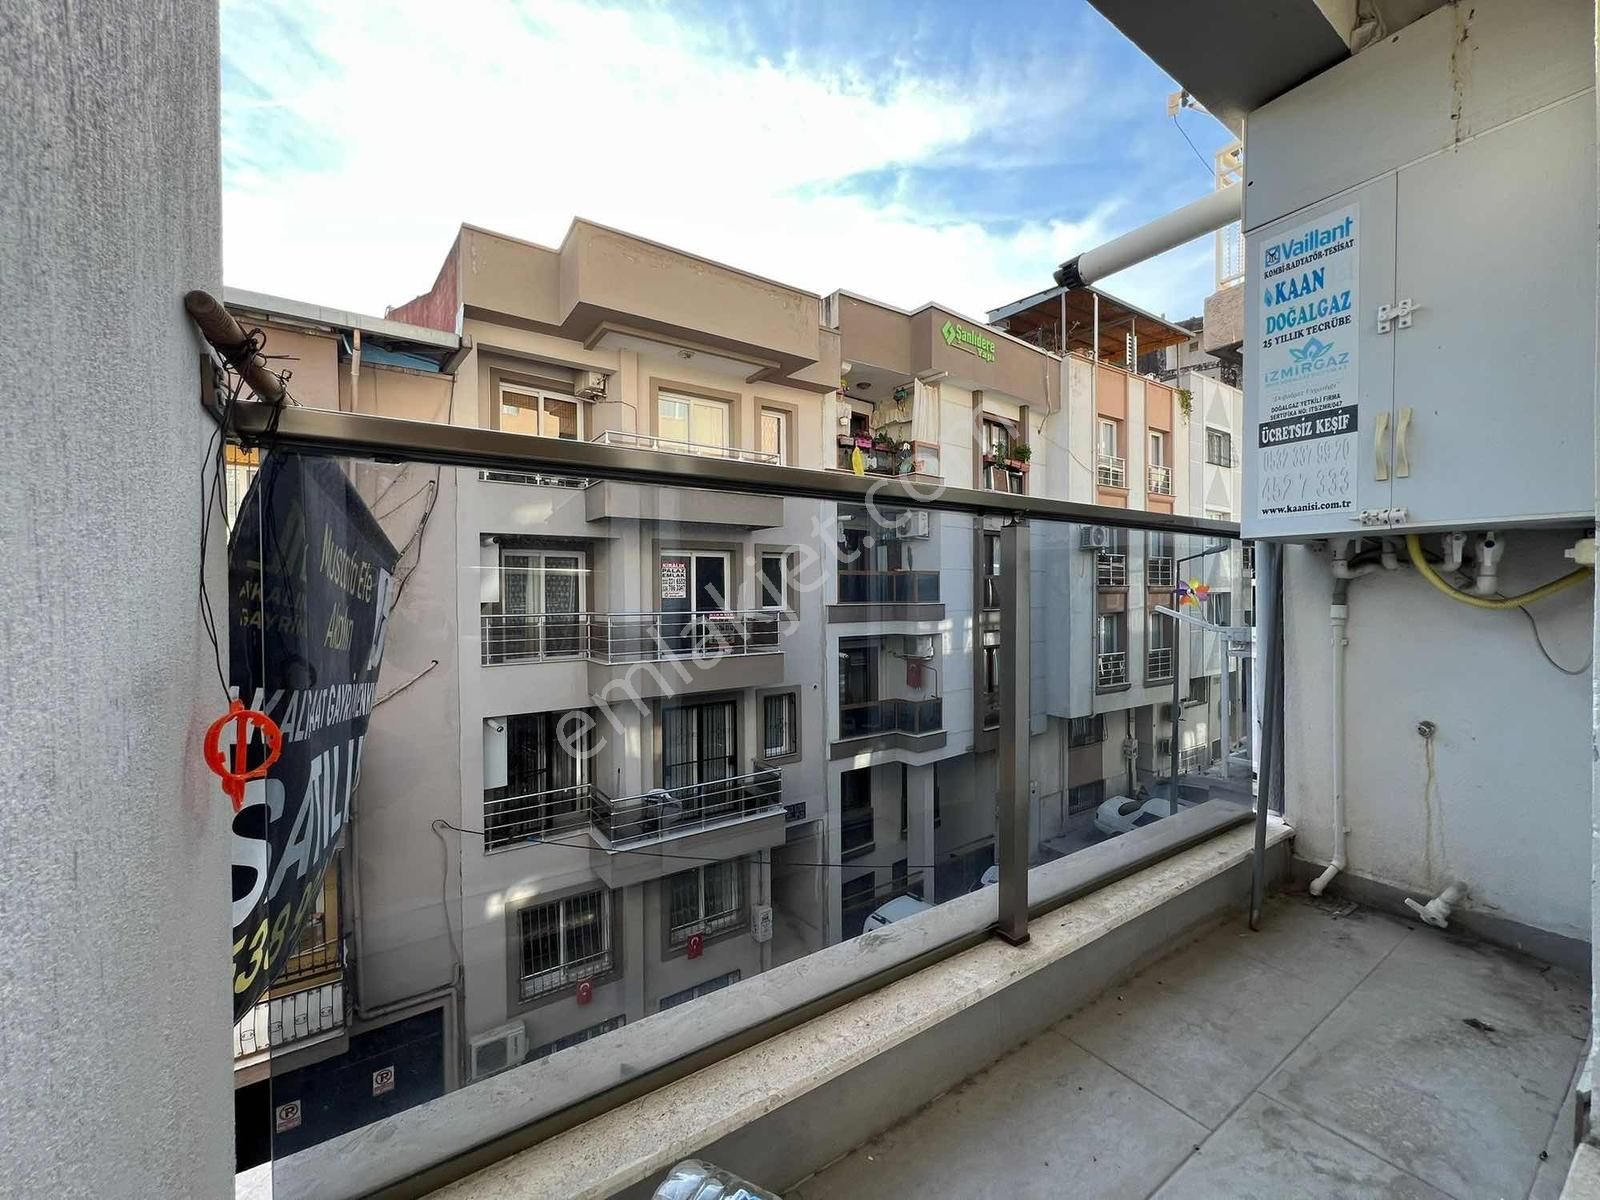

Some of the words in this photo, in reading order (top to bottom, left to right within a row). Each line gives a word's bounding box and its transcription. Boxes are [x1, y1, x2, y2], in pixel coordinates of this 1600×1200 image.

[1282, 216, 1353, 259] Vaillant
[1275, 267, 1325, 305] KAAN
[1266, 290, 1352, 335] DOĞALGAZ
[1274, 328, 1304, 345] YILLIK
[1305, 315, 1352, 336] TECRÜBE
[1261, 417, 1313, 444] ÜCRETSİZ
[1315, 410, 1350, 434] KEŞİF
[1261, 500, 1352, 515] www.kaanisi.com.tr
